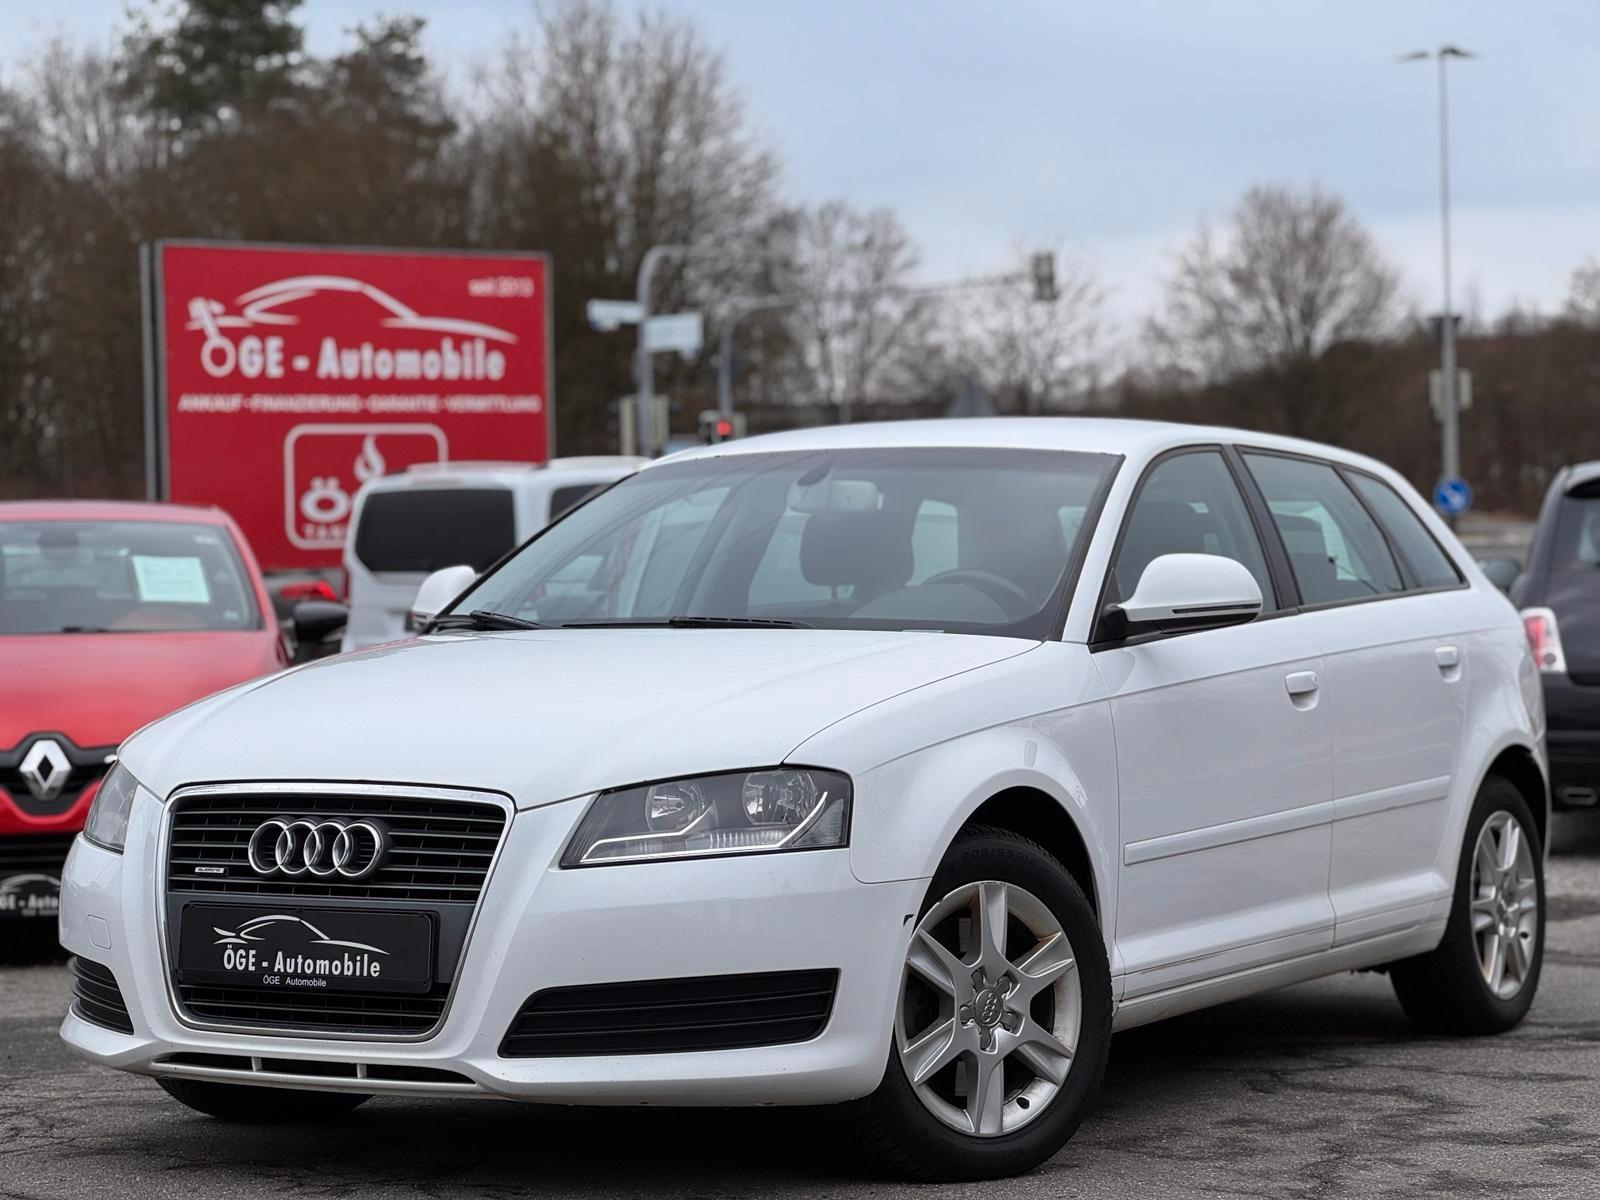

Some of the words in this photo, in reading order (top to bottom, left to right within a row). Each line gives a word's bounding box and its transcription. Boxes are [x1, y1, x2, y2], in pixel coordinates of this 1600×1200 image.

[316, 336, 506, 381] Automobile
[224, 944, 256, 971] ÖGE
[274, 951, 381, 977] Automobile
[263, 974, 280, 985] ÖGE
[286, 976, 327, 987] Automobile
